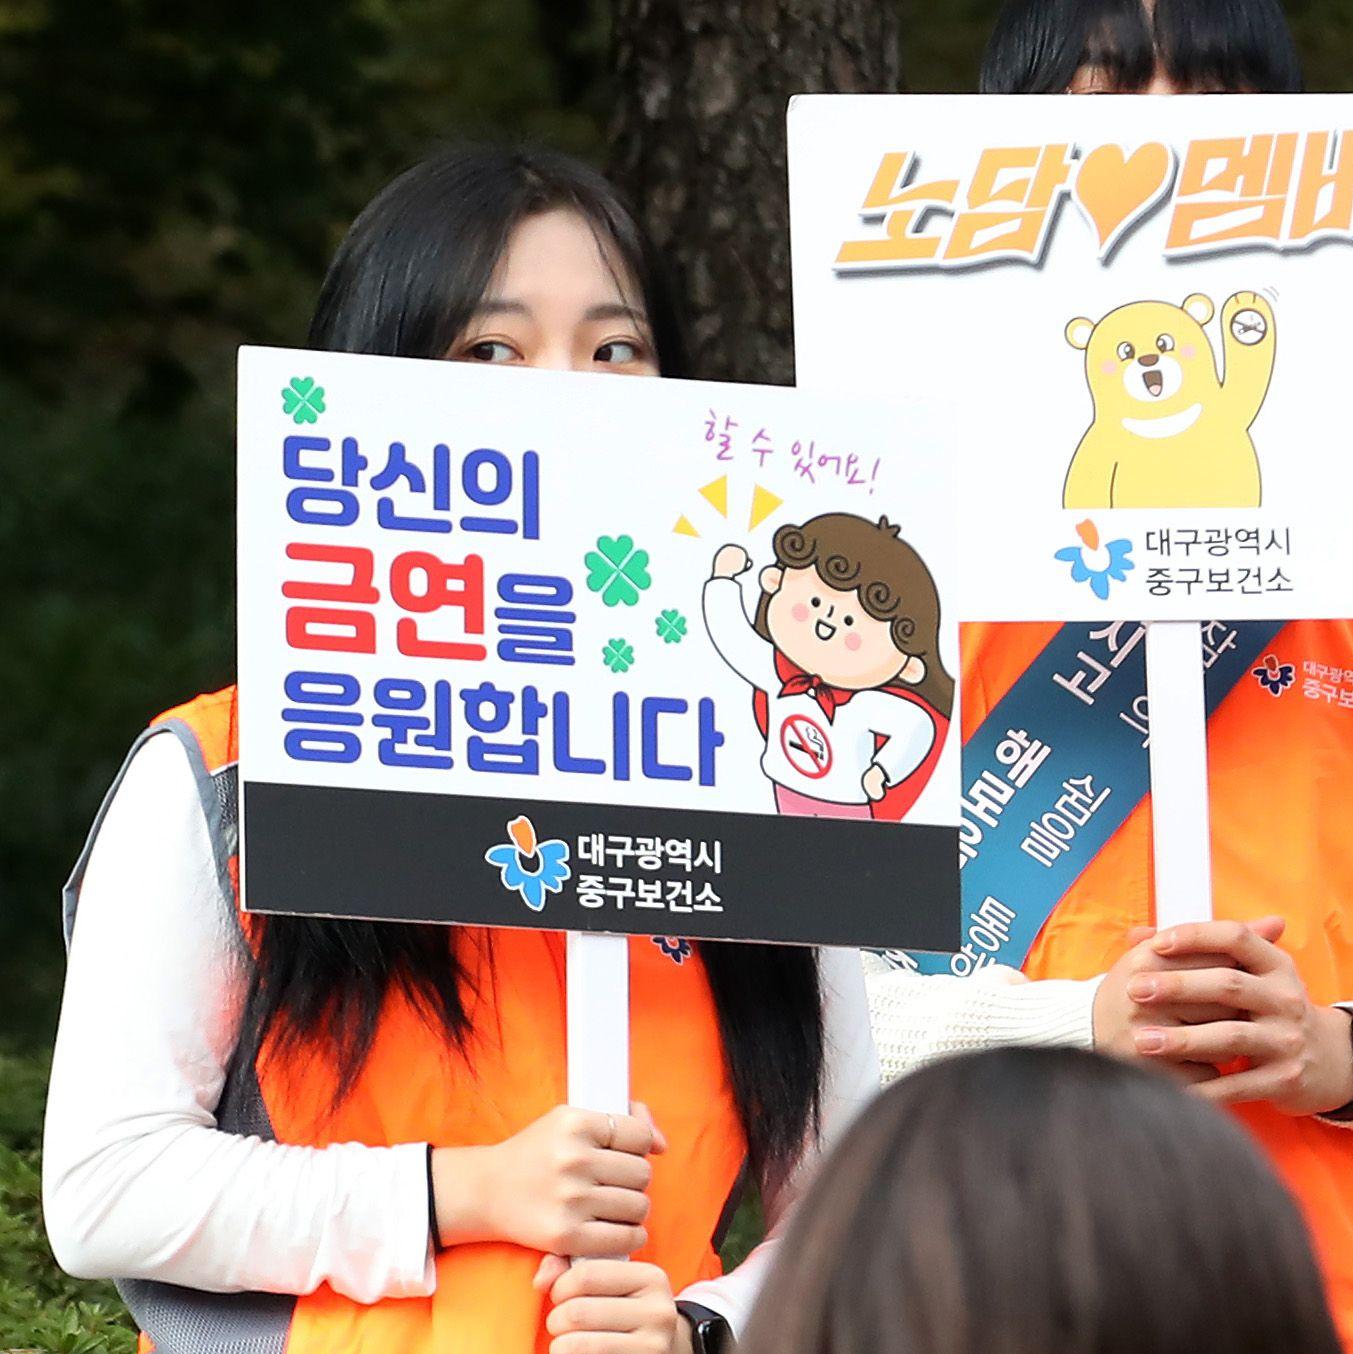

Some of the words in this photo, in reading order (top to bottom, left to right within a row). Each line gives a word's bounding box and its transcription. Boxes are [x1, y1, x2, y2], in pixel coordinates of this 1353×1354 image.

[832, 141, 1076, 280] 노담
[281, 433, 542, 541] 당신의
[703, 408, 736, 462] 할
[750, 426, 776, 467] 수
[790, 438, 882, 495] 있어요!
[1145, 526, 1293, 559] 대구광역시
[1145, 566, 1295, 598] 중구보건소
[280, 541, 578, 668] 금연을
[280, 669, 726, 788] 응원합니다
[575, 875, 726, 915] 중구보건소
[576, 832, 724, 877] 대구광역시
